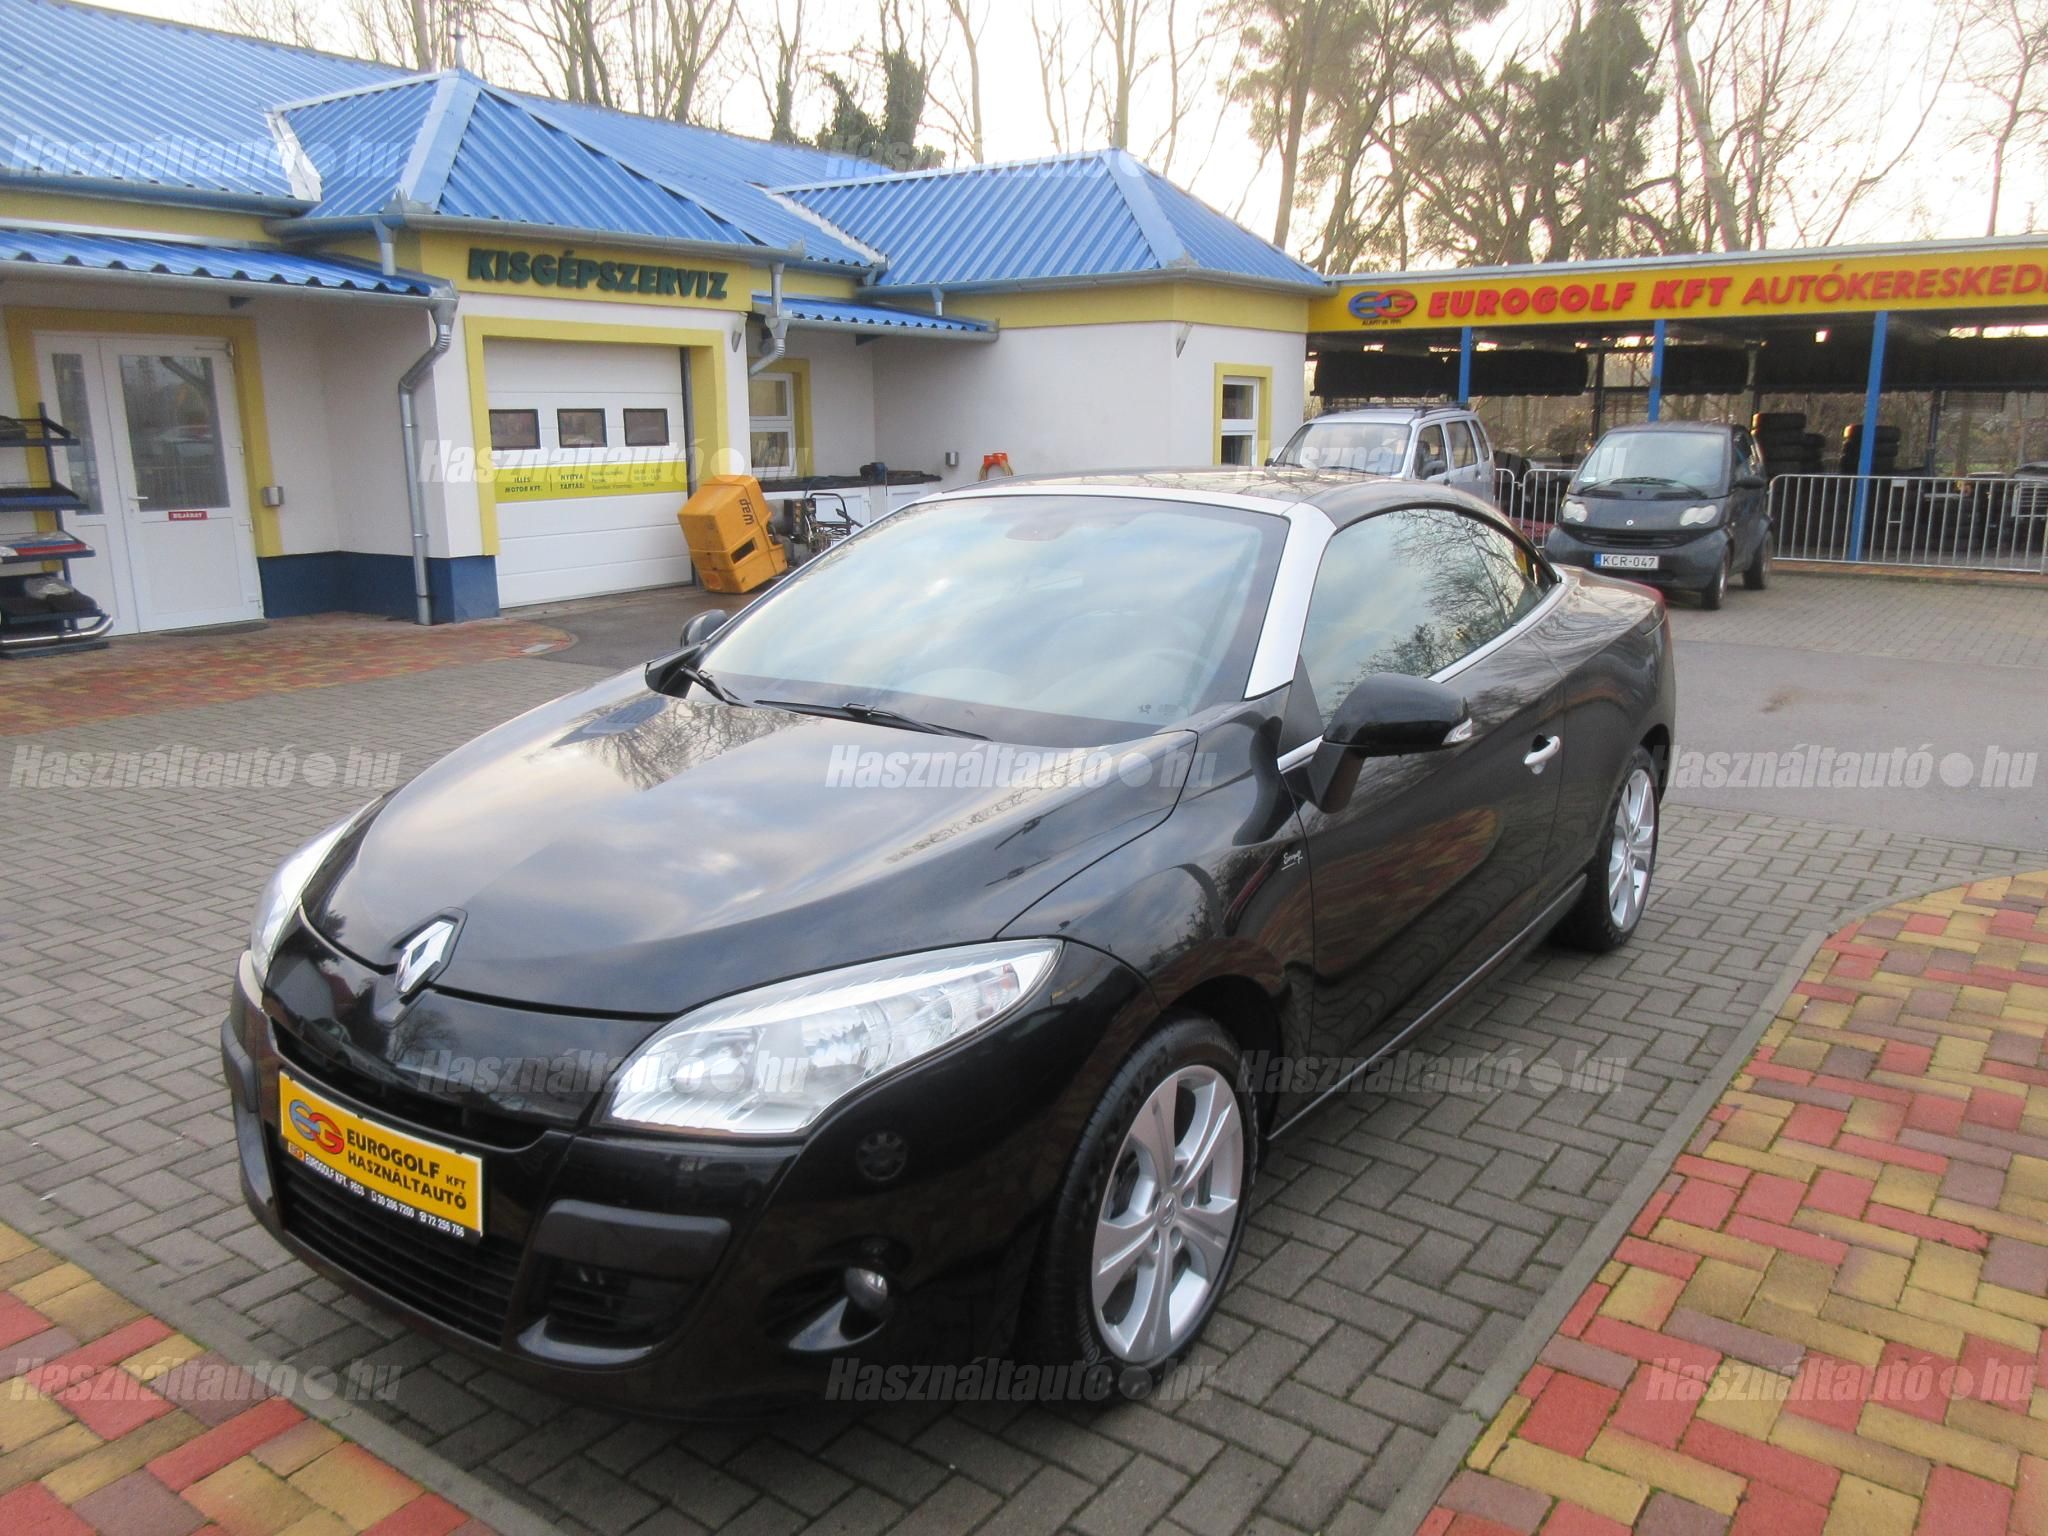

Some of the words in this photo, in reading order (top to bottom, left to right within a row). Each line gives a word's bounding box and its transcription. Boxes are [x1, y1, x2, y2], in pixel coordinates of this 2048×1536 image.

[468, 248, 728, 299] KISGÉPSZERVIZ
[1428, 282, 1636, 318] EUROGOLF
[1650, 277, 1733, 309] KFT
[1741, 263, 2048, 305] AUTÓKERESKED
[1602, 555, 1656, 567] KCR-047
[347, 1127, 440, 1179] EUROGOLF
[446, 1174, 467, 1191] KFT
[347, 1150, 467, 1210] HASZNÁLTAUTÓ
